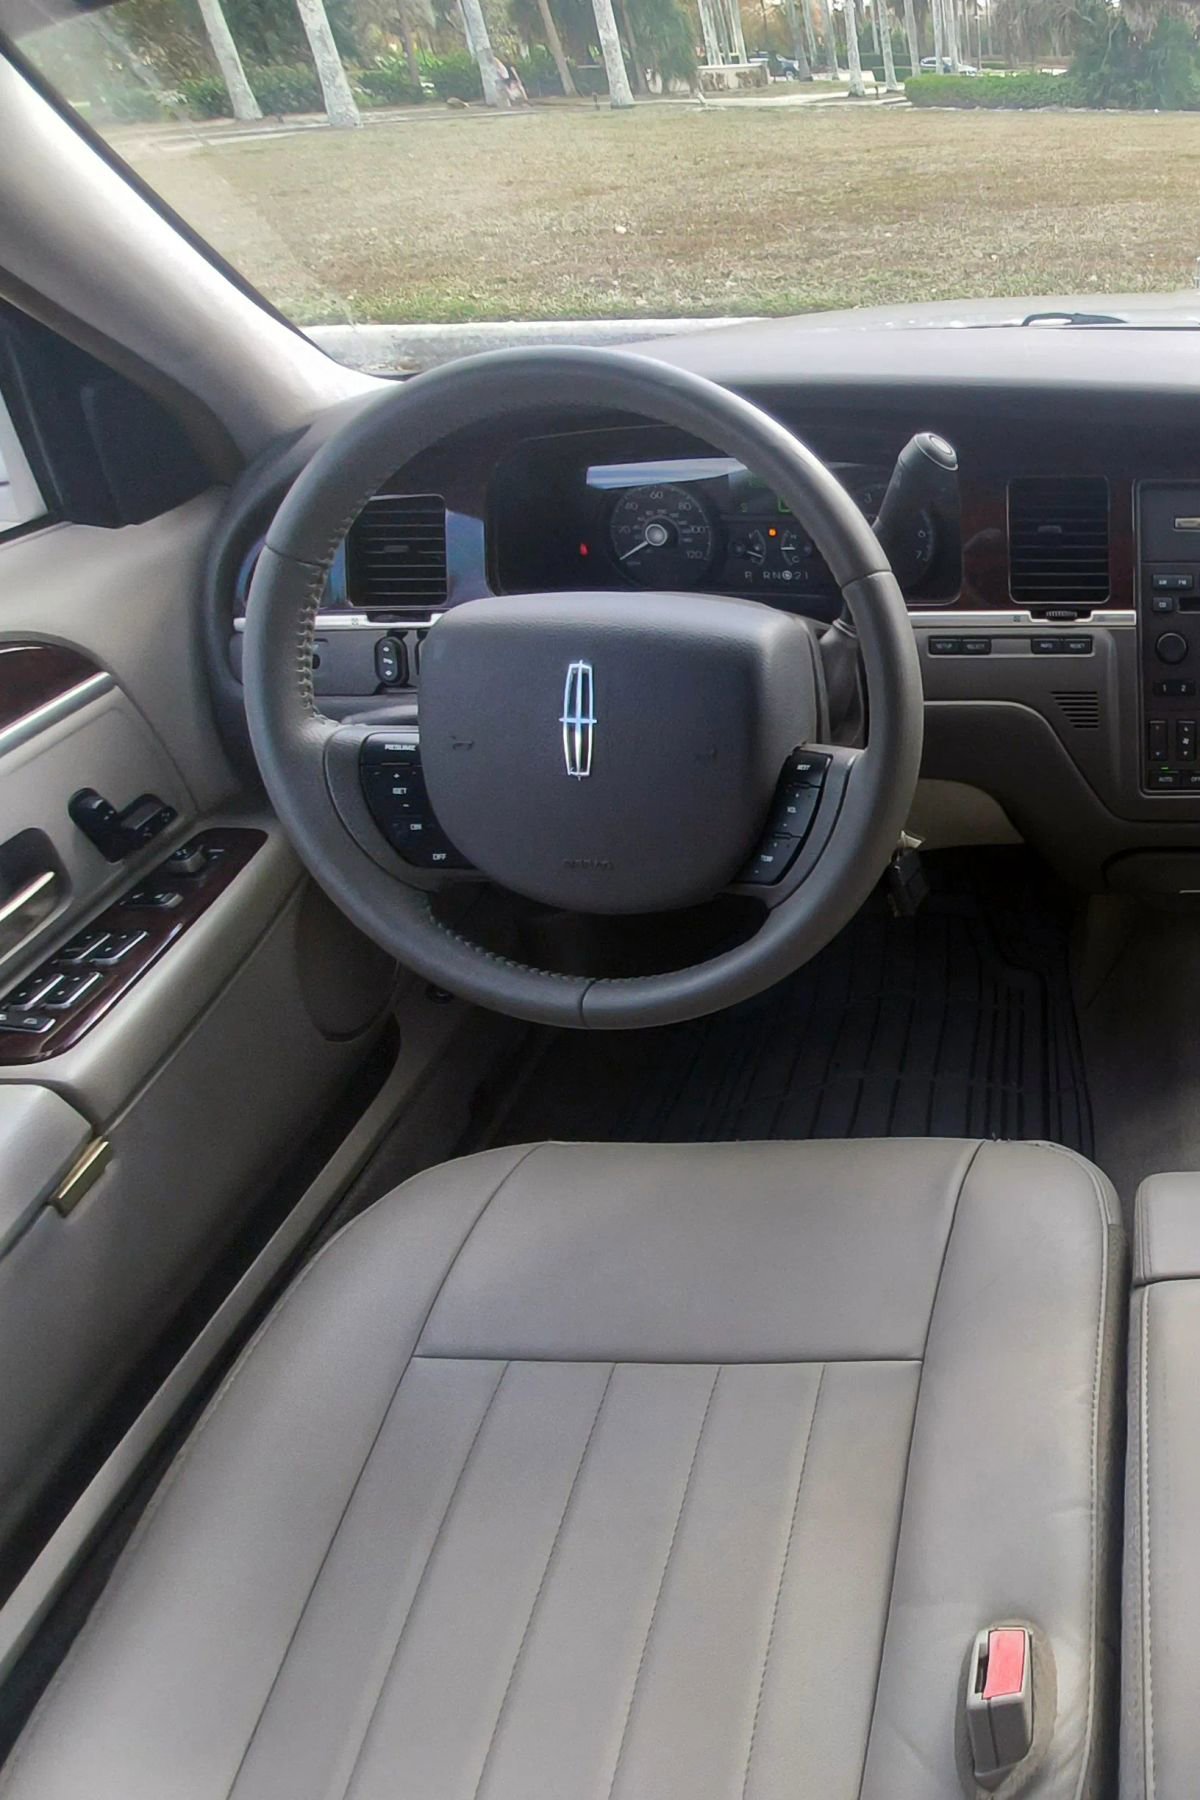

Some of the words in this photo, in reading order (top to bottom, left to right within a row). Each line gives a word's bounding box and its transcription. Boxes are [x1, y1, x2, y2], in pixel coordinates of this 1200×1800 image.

[649, 491, 664, 500] 60
[384, 743, 417, 751] RESUME
[432, 852, 447, 861] OFF
